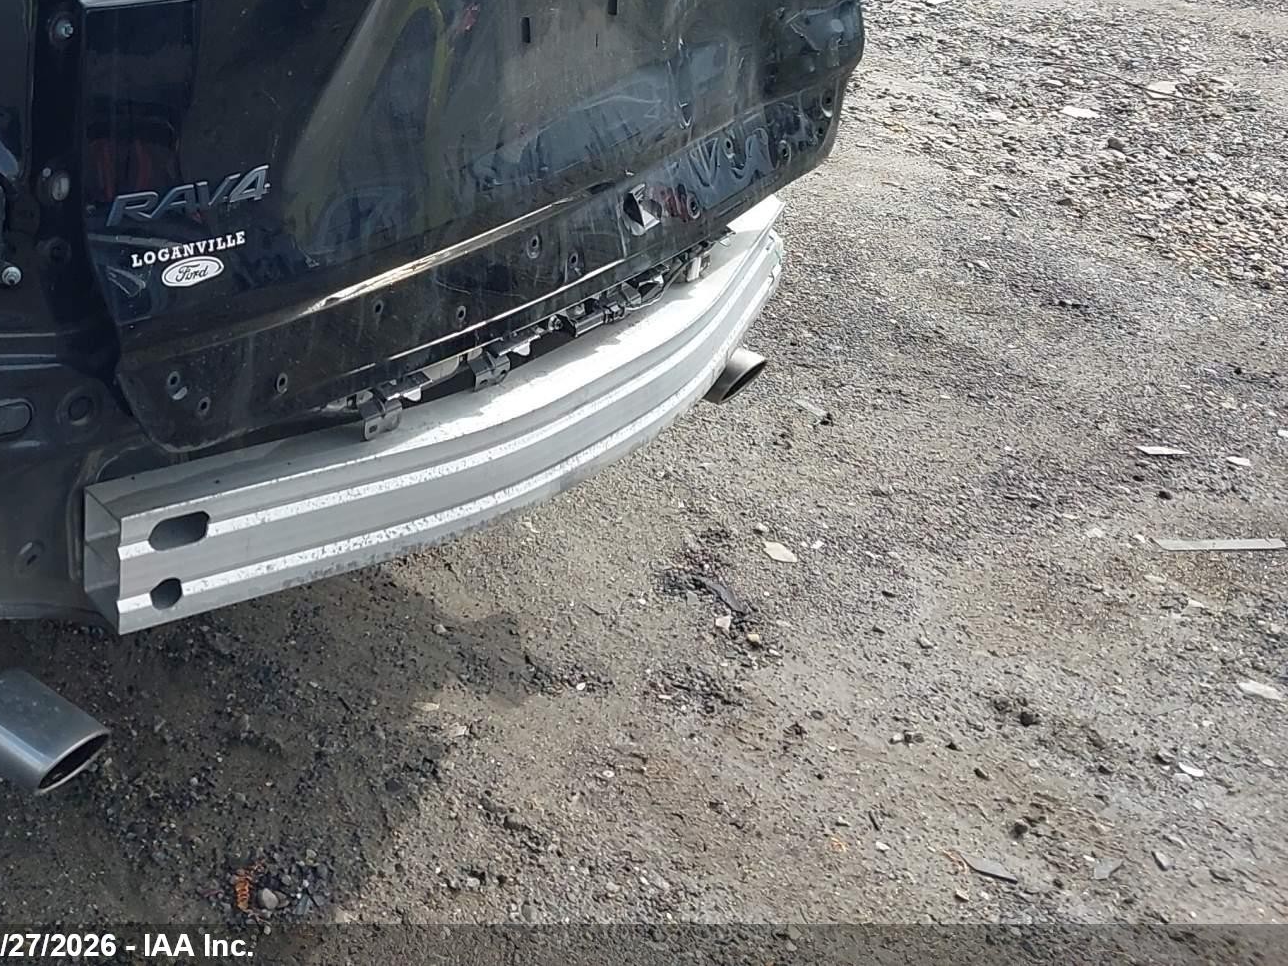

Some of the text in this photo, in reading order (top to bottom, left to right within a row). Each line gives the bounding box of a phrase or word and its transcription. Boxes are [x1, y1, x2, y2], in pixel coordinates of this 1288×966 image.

[106, 164, 271, 227] RAV4
[130, 231, 246, 268] LOGANVILLE
[175, 262, 209, 282] Ford
